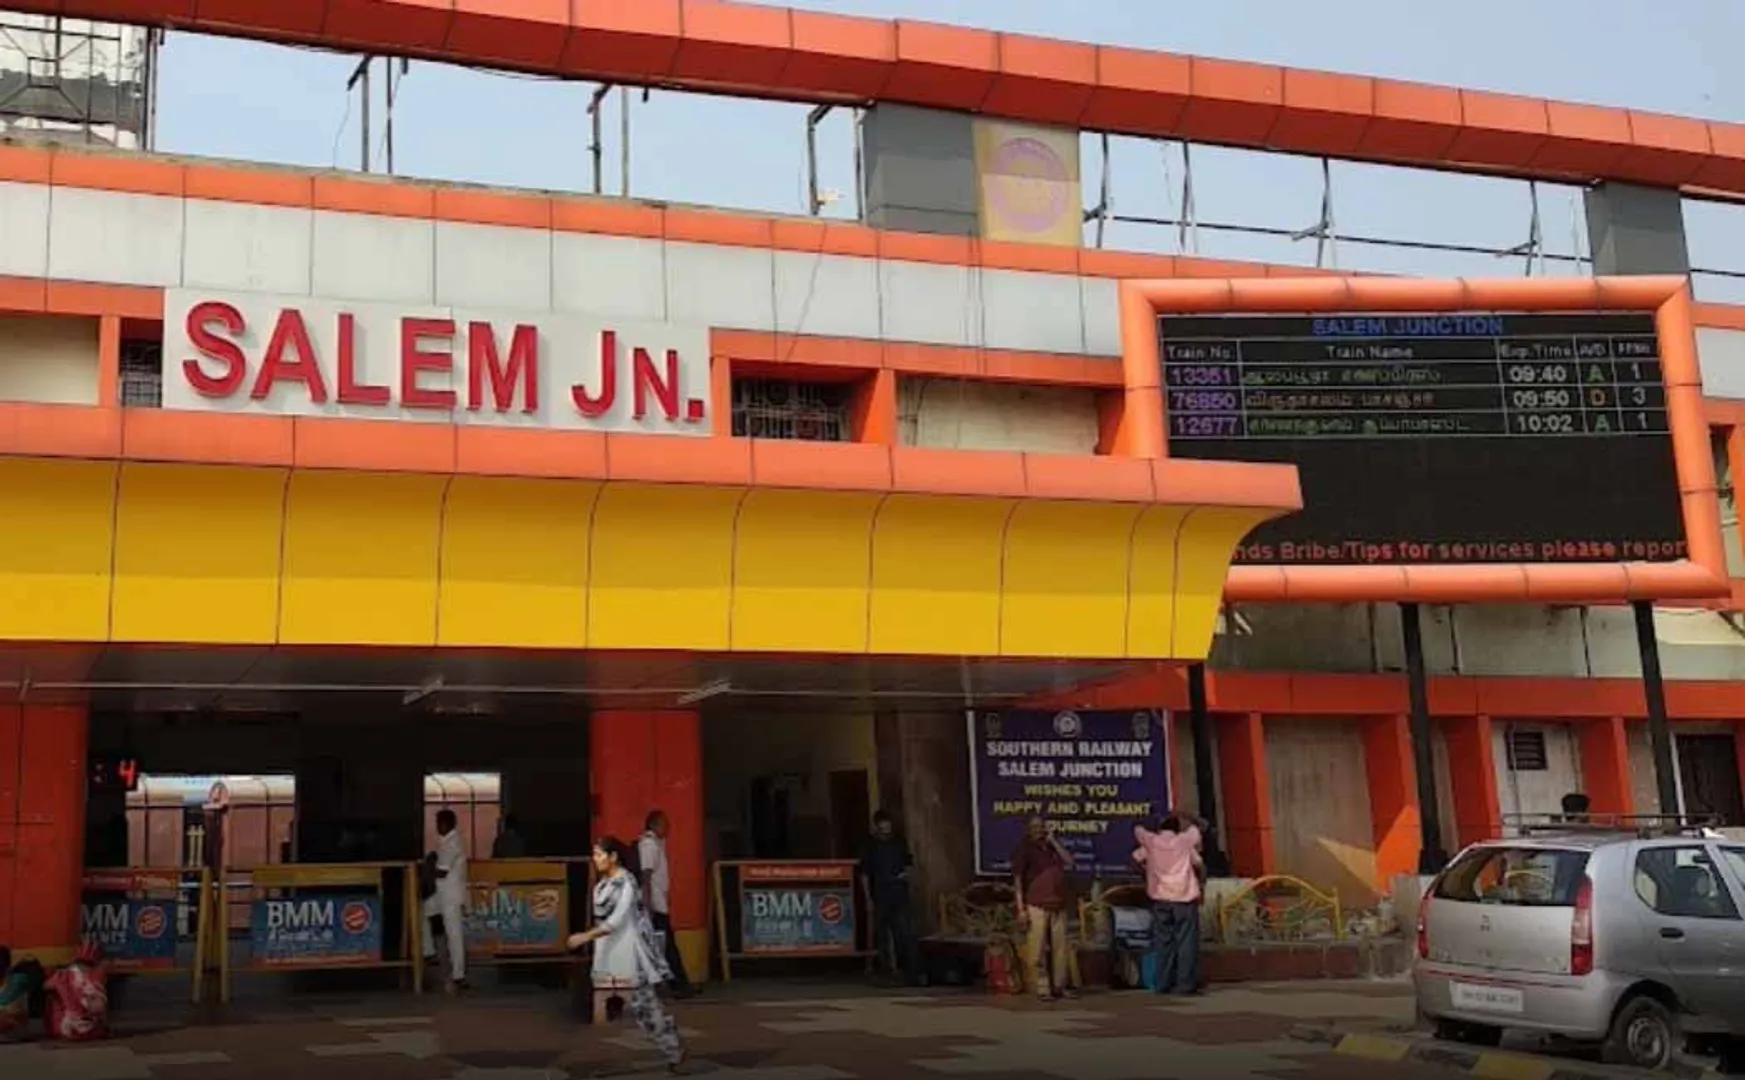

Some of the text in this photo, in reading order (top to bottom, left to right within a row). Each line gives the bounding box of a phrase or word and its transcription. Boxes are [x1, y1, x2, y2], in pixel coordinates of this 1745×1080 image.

[1313, 316, 1503, 335] SALEM JUNCTION
[1167, 345, 1204, 359] Train
[1327, 345, 1413, 358] Train Name
[182, 300, 706, 422] SALEM JN.
[1509, 364, 1567, 382] 09:40
[1588, 364, 1605, 381] A
[1630, 363, 1642, 380] 1
[1172, 392, 1236, 409] 76850
[1512, 389, 1570, 407] 09:50
[1591, 388, 1606, 406] D
[1632, 388, 1646, 405] 3
[1178, 416, 1238, 434] 12677
[1517, 414, 1574, 432] 10:02
[1594, 414, 1611, 432] A
[1636, 413, 1648, 431] 1
[1232, 543, 1273, 559] nds
[1280, 541, 1393, 562] Bribe/Tips
[1400, 540, 1429, 558] for
[1439, 542, 1534, 559] services
[1542, 540, 1616, 561] please
[986, 741, 1153, 757] SOUTHERN RAILWAY
[998, 762, 1143, 777] SALEM JUNCTION
[1023, 784, 1119, 797] WISHES YOU
[993, 801, 1151, 815] HAPPY AND PLEASANT
[1046, 820, 1110, 834] OURNEY
[752, 892, 812, 917] BMM
[81, 903, 129, 931] MM
[266, 900, 334, 928] BMM
